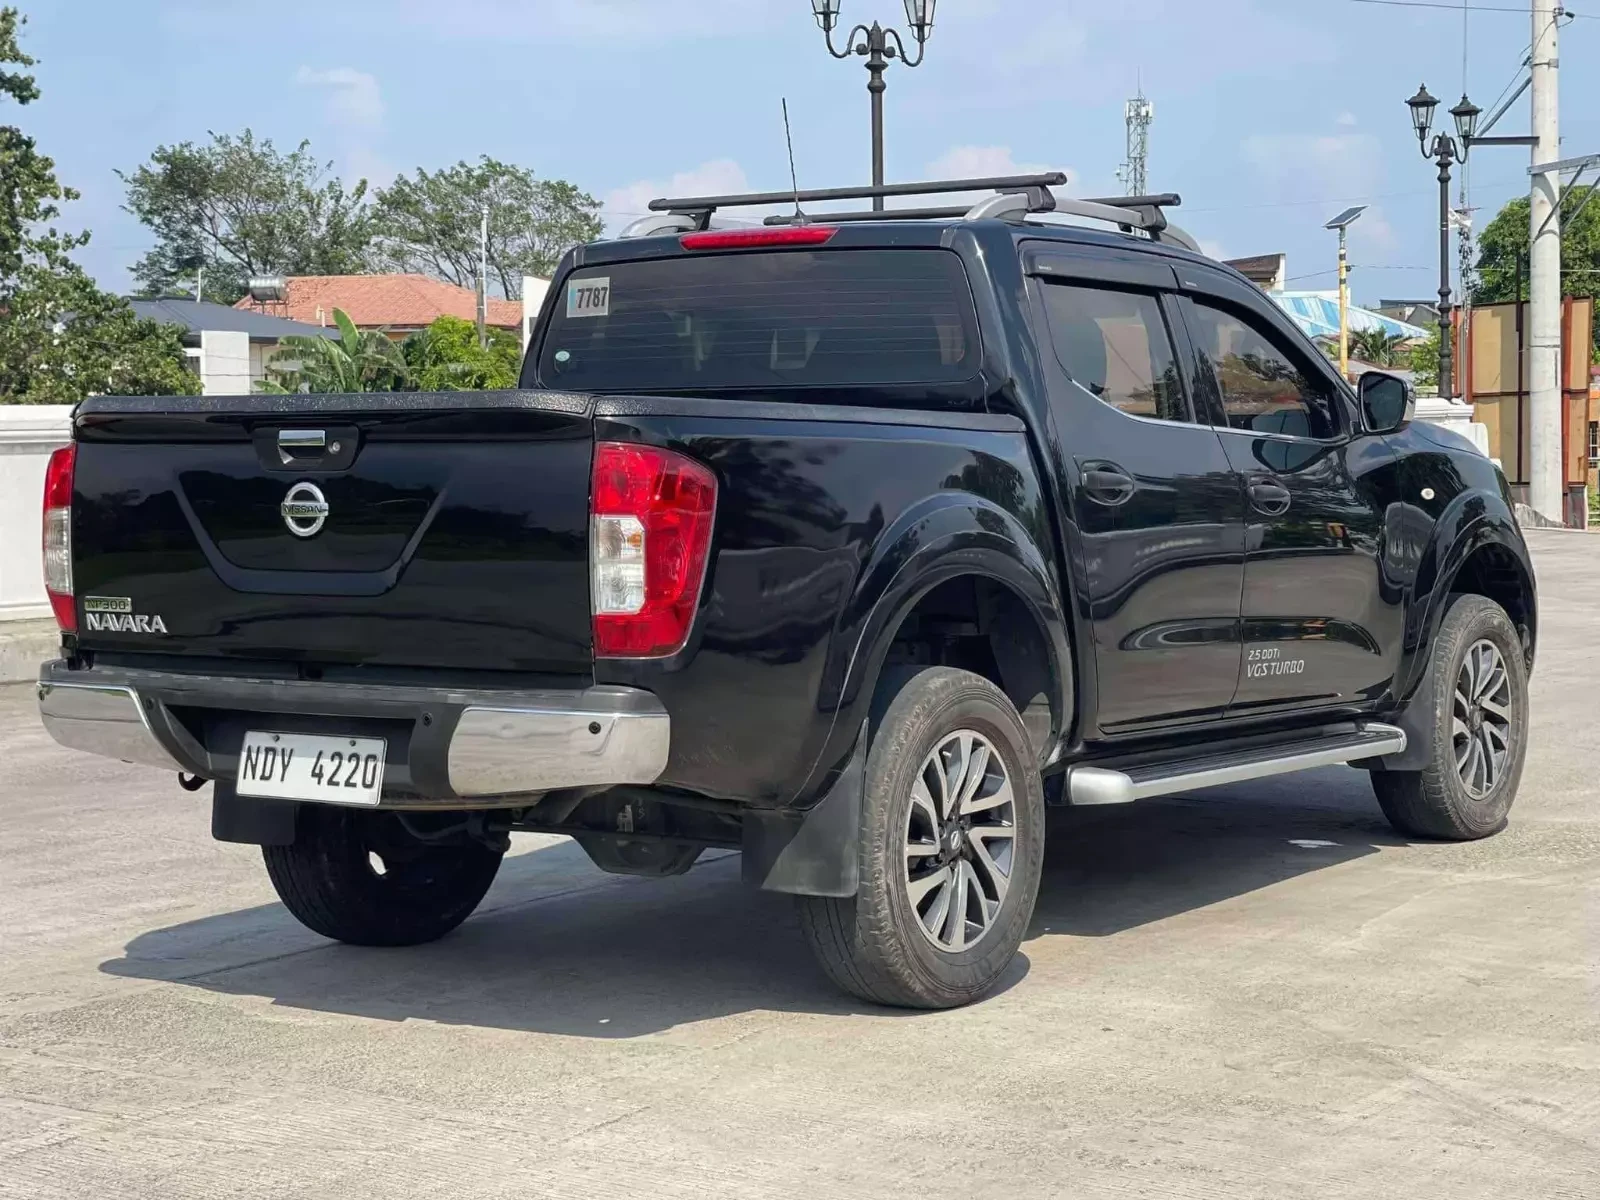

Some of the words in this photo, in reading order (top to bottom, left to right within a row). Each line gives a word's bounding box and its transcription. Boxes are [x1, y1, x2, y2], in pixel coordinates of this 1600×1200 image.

[577, 286, 608, 309] 7787
[283, 503, 322, 515] NISSAN
[86, 612, 168, 633] NAVARA
[1270, 659, 1305, 675] TURBO
[243, 745, 294, 782] NDY
[311, 750, 377, 788] 4220
